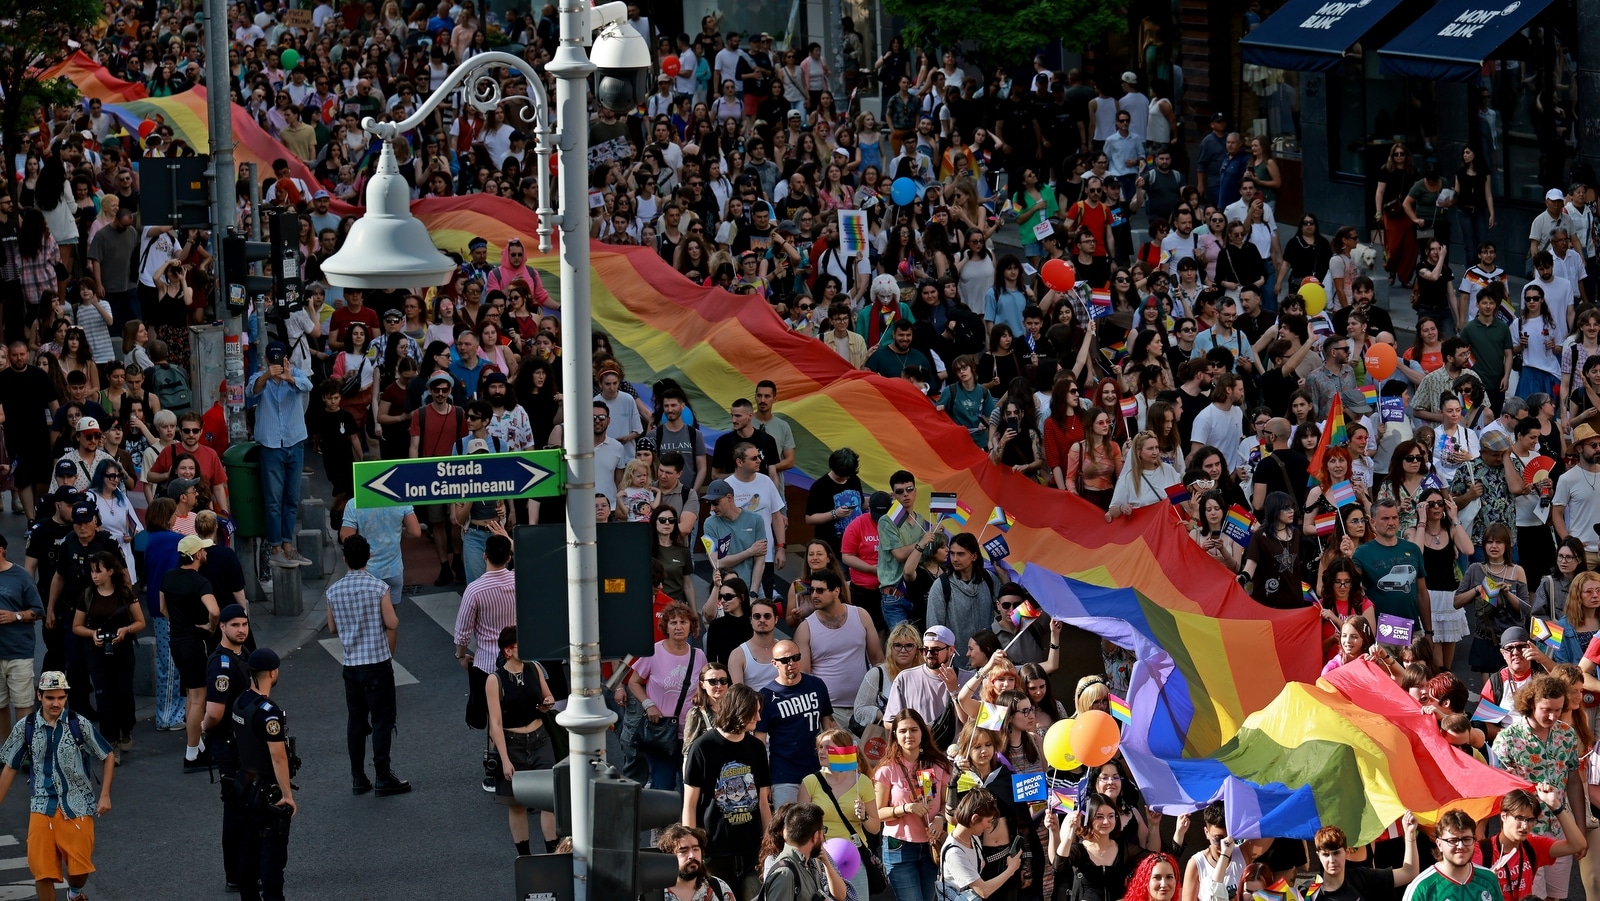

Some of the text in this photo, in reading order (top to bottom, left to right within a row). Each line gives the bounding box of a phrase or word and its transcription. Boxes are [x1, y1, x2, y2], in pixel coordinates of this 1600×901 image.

[1315, 2, 1357, 16] MONT
[1454, 9, 1501, 24] MONT
[1299, 15, 1342, 30] BLANC
[1437, 24, 1485, 39] BLANC
[437, 462, 482, 477] Strada
[405, 479, 515, 500] Ion Câmpineanu
[803, 711, 821, 732] 77
